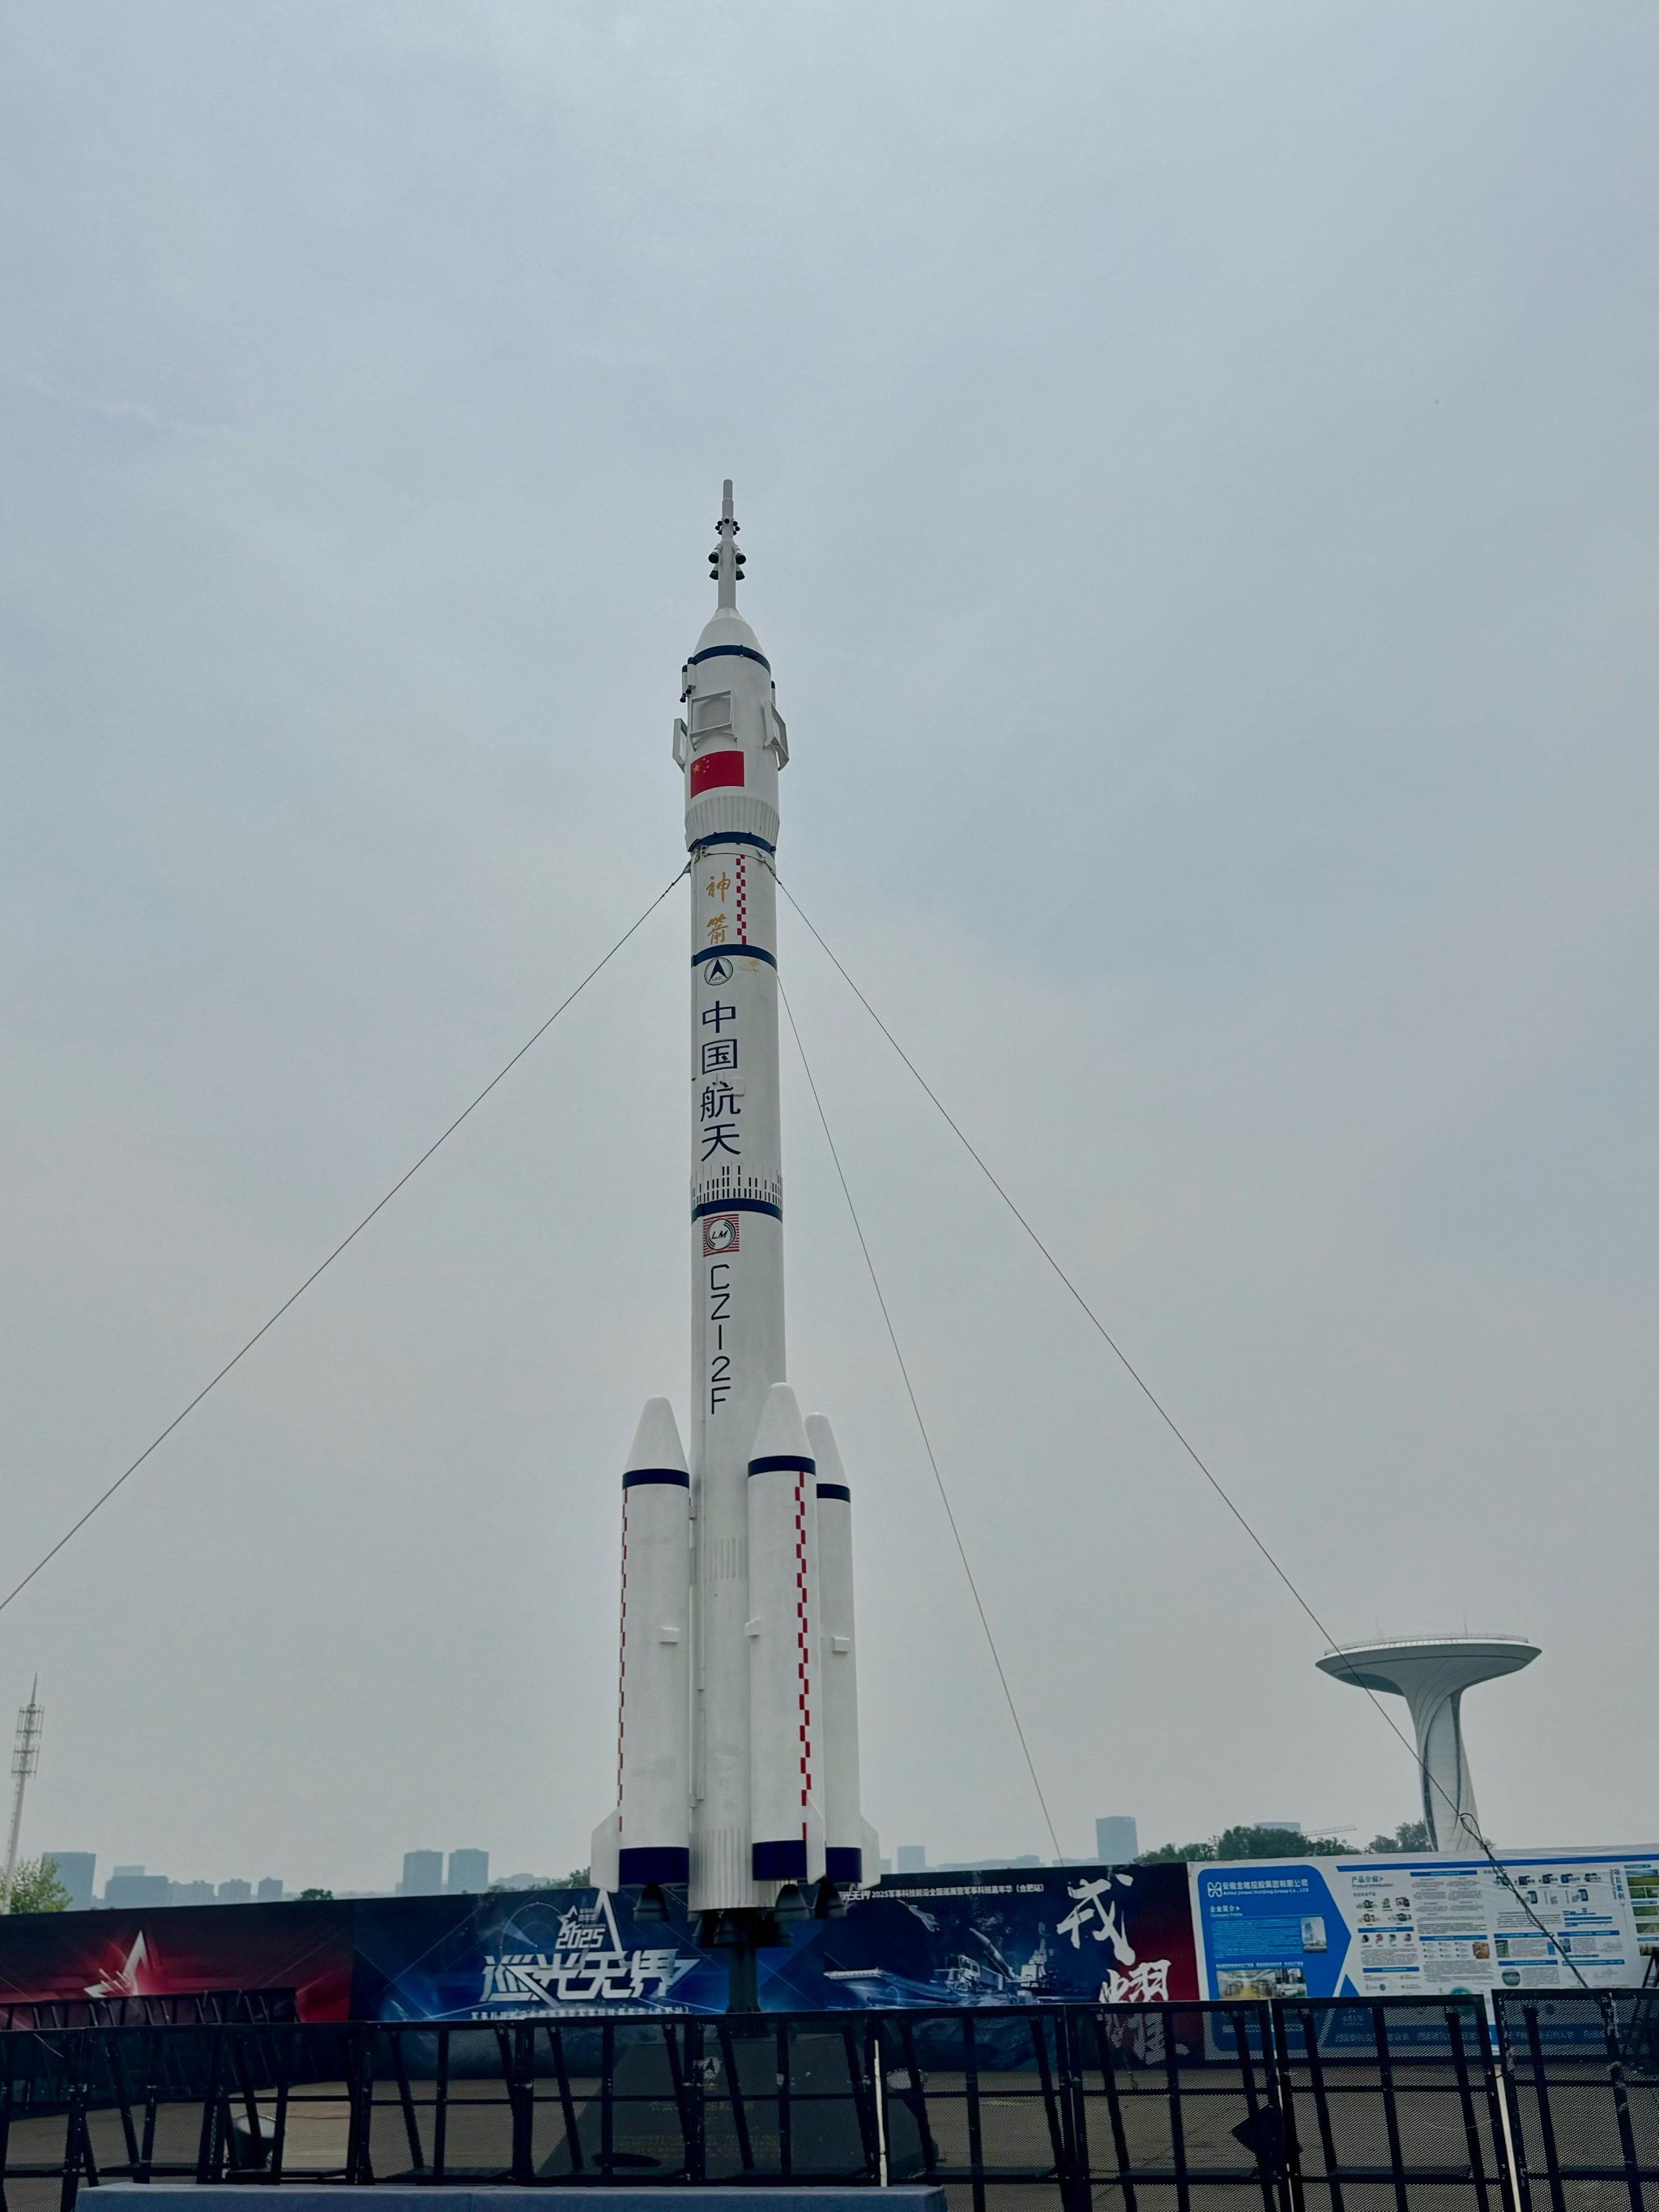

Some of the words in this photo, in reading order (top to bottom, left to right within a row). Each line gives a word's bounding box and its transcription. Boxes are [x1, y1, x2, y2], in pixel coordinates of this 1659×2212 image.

[706, 872, 731, 945] 神箭
[700, 1000, 741, 1162] 中国航天
[555, 1928, 606, 1949] 2025
[479, 1949, 680, 2002] 巡光无界
